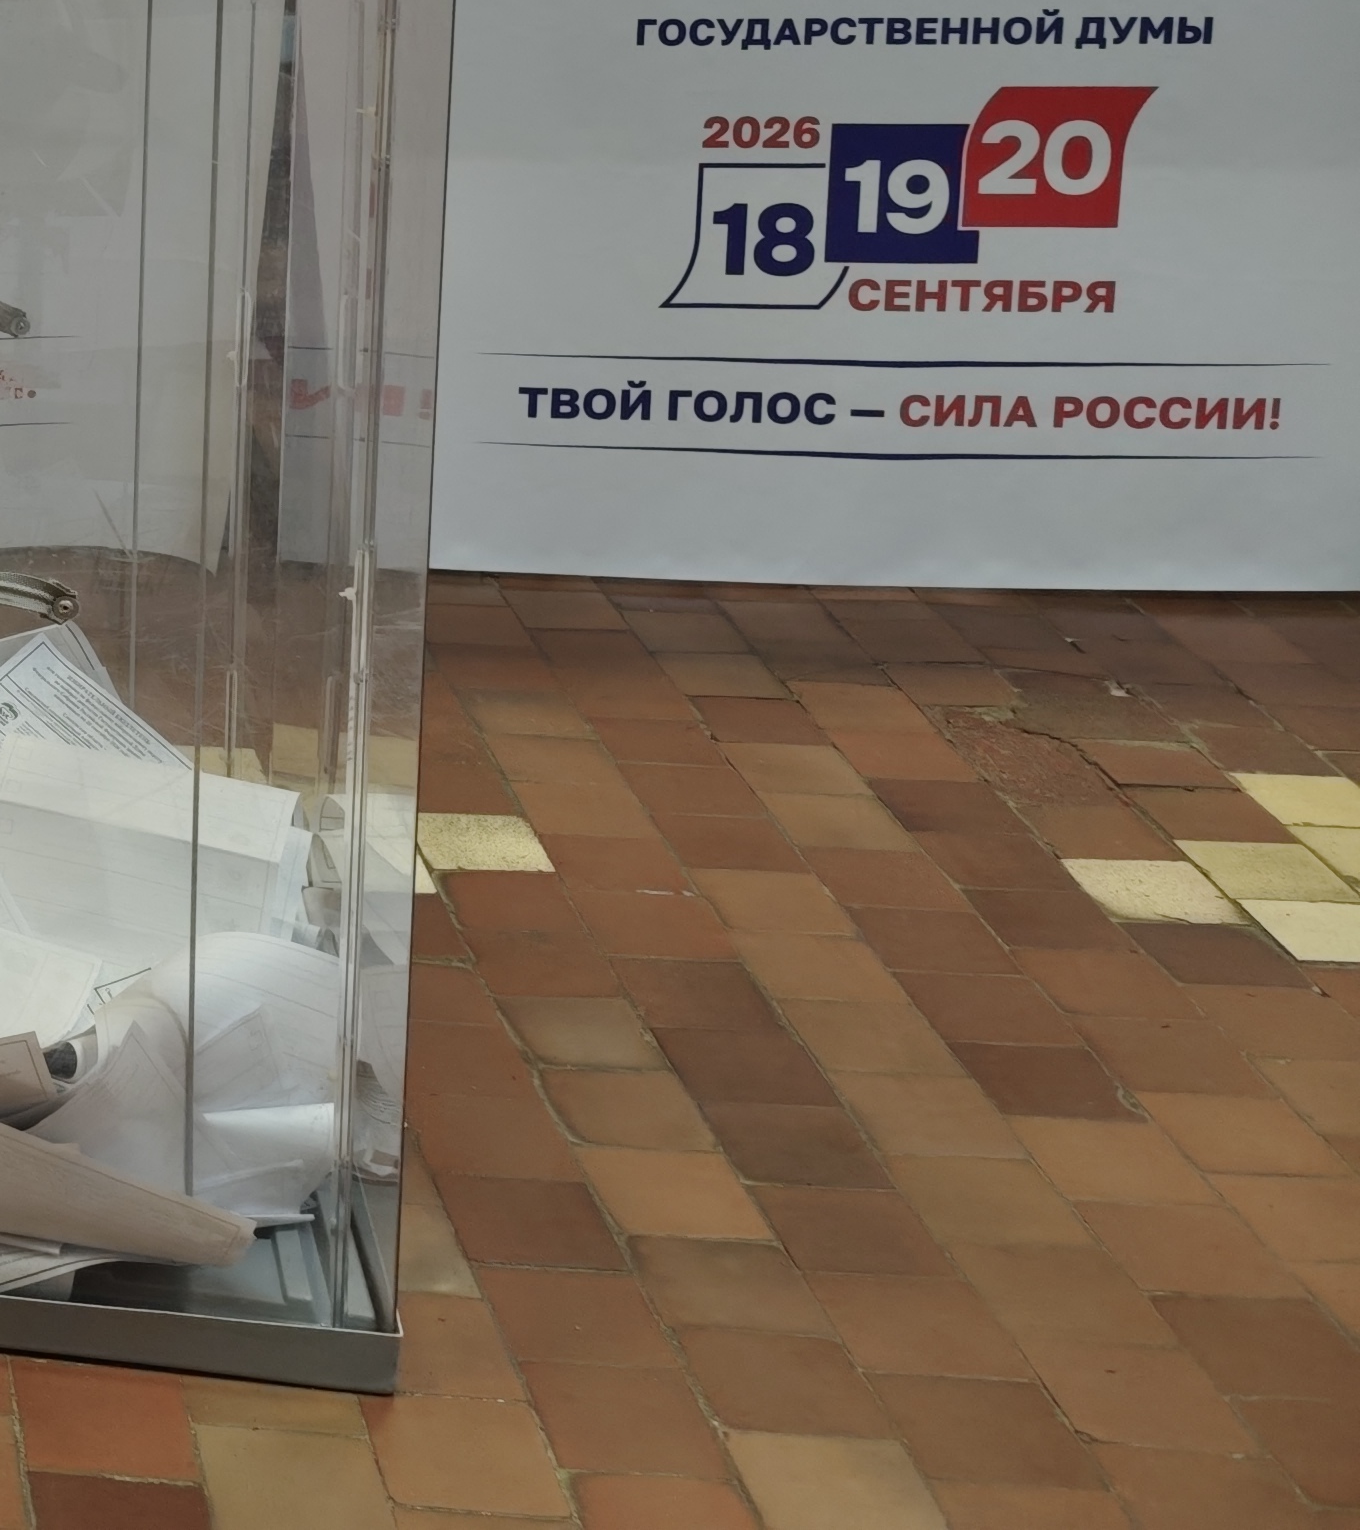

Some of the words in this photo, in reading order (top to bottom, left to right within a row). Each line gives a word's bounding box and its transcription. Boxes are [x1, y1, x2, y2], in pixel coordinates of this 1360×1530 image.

[635, 9, 1064, 50] ГОСУДАРСТВЕННОЙ
[1074, 15, 1215, 49] ДУМЫ
[702, 115, 821, 151] 2026
[711, 201, 816, 277] 18
[843, 157, 950, 235] 19
[977, 117, 1113, 197] 20
[847, 278, 1116, 314] СЕНТЯБРЯ
[518, 379, 653, 421] ТВОЙ
[666, 390, 837, 427] ГОЛОС
[899, 394, 1037, 429] СИЛА
[1053, 396, 1281, 432] РОССИИ!
